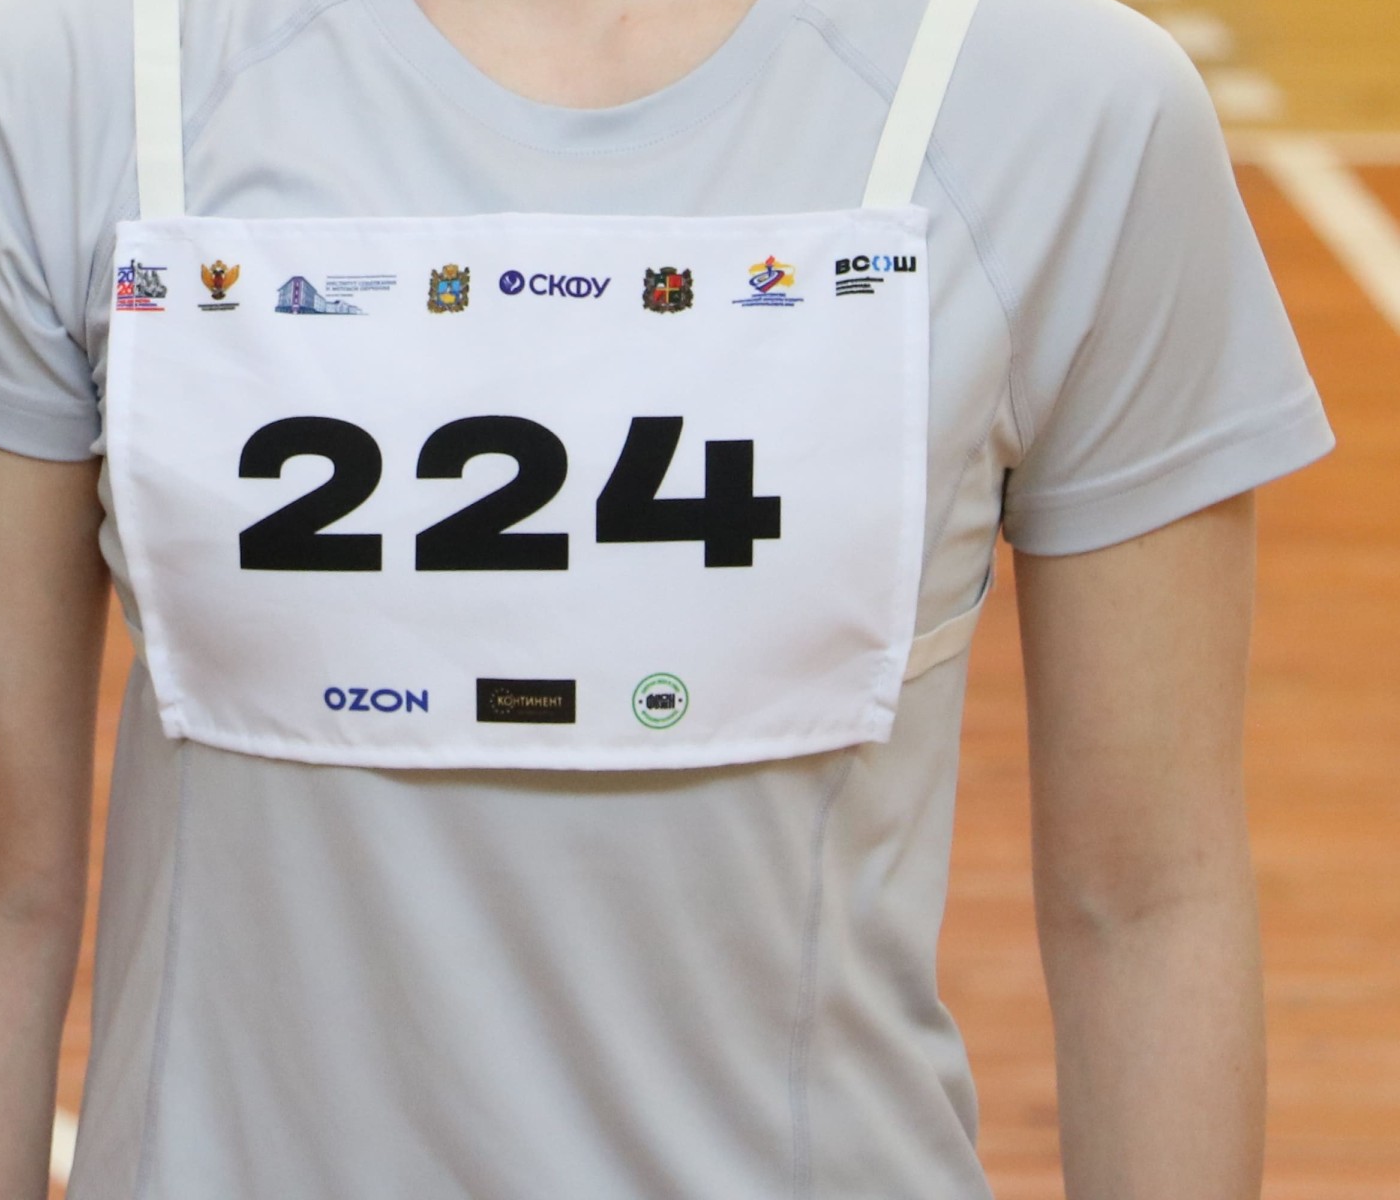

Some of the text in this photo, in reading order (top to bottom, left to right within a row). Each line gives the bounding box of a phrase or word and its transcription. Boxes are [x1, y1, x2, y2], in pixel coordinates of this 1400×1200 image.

[528, 273, 611, 299] СКФУ
[239, 415, 781, 572] 224
[324, 686, 429, 713] OZON
[497, 695, 563, 708] КОНТИНЕНТ
